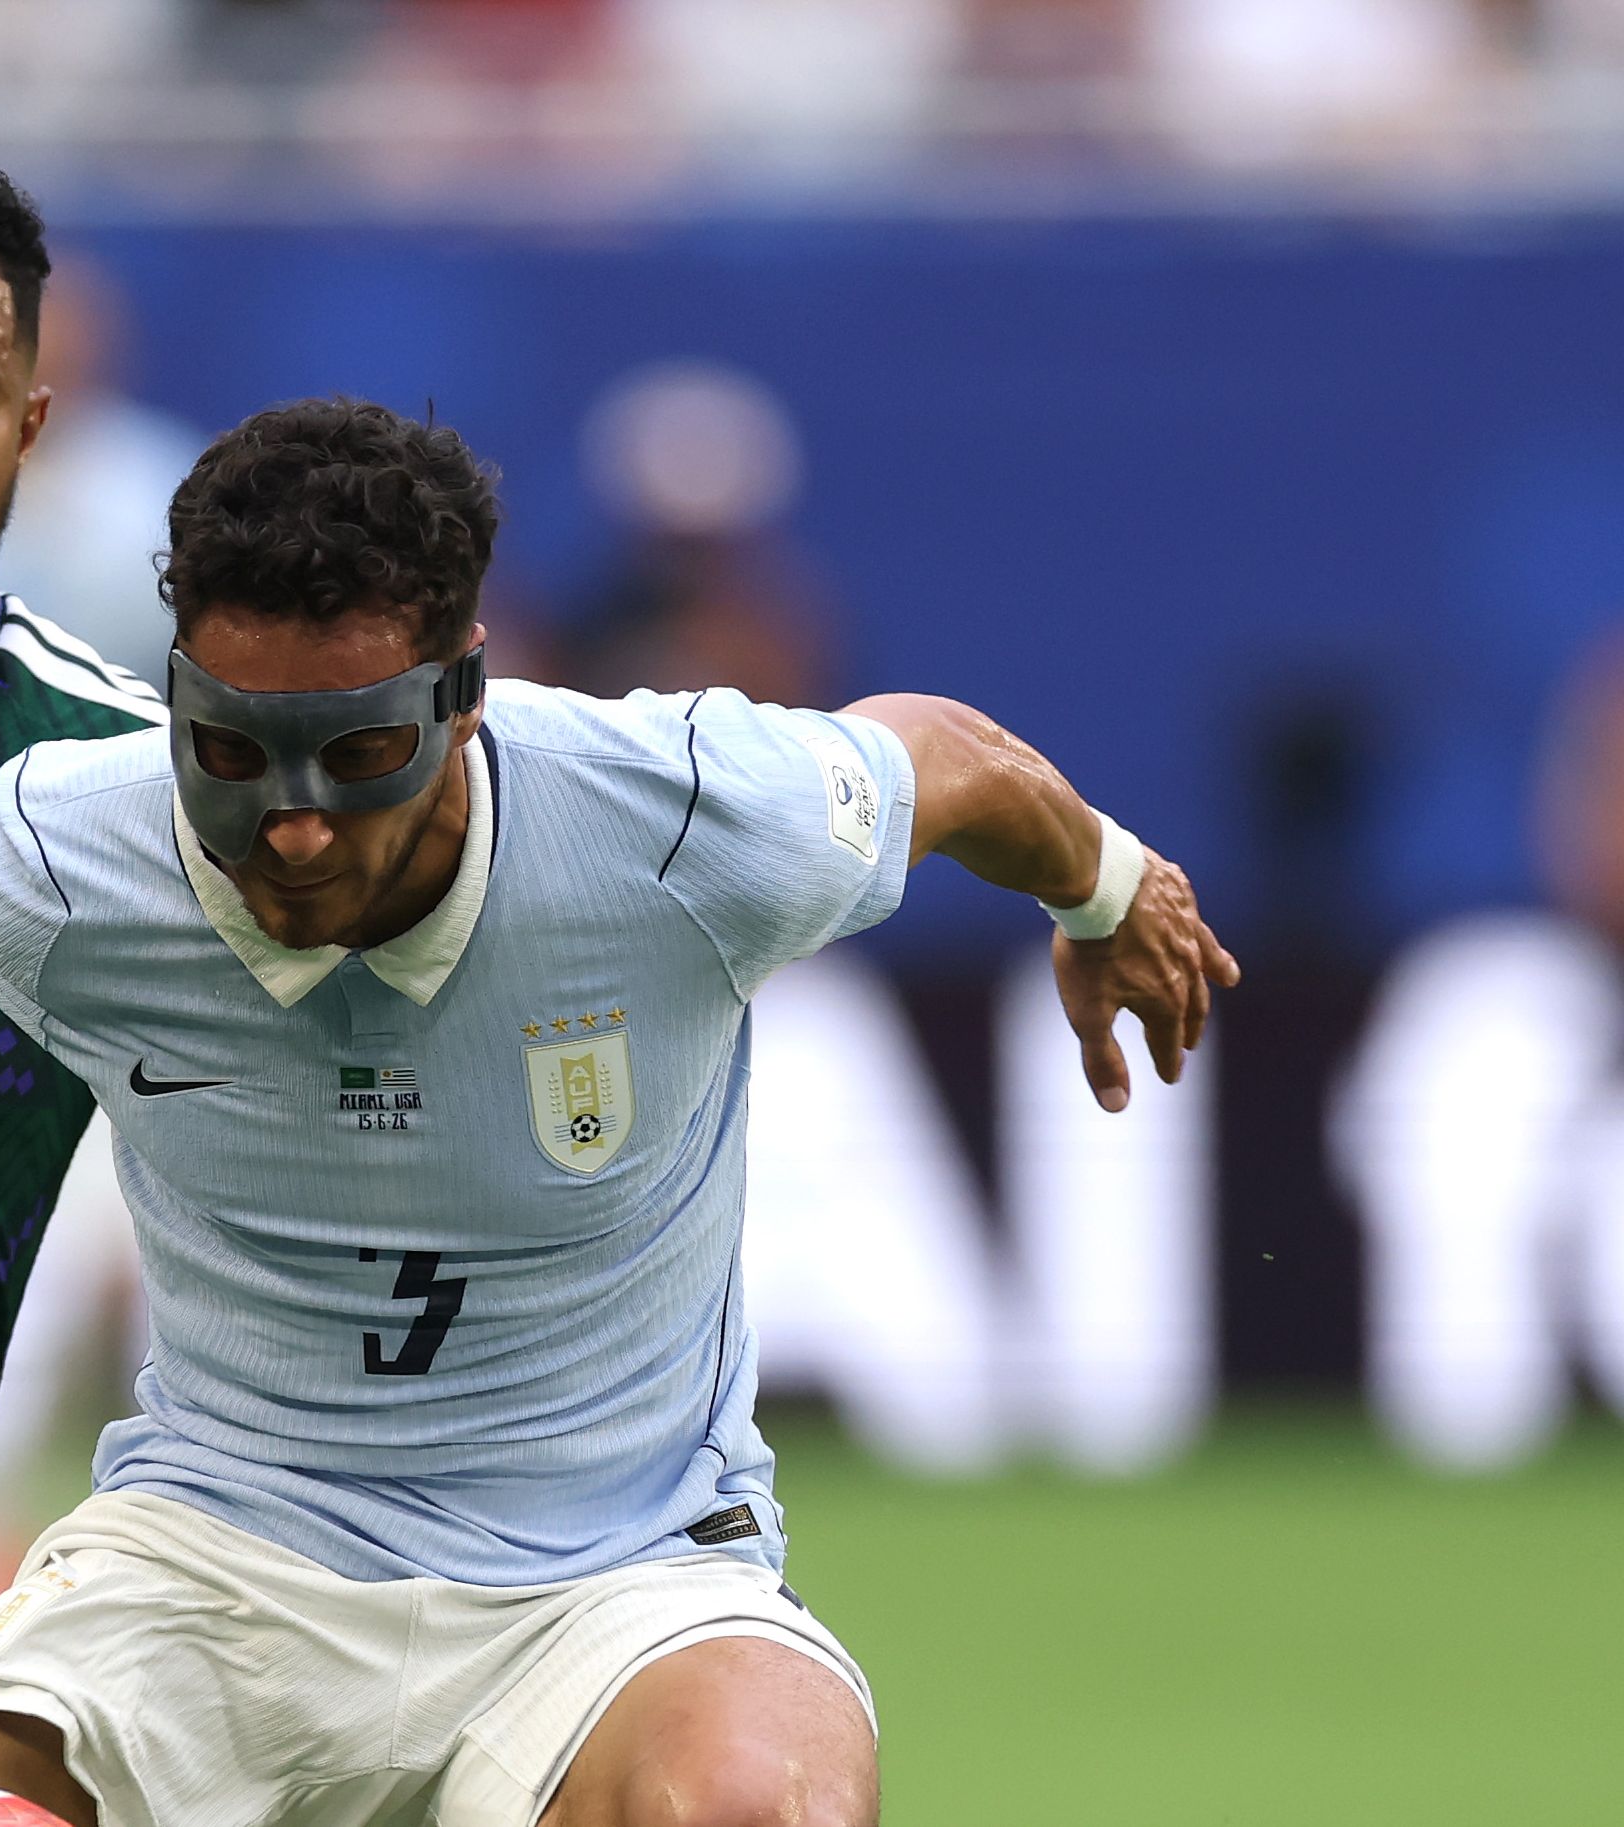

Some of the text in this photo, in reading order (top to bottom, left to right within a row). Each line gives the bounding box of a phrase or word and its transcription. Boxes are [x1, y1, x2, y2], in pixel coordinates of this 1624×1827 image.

[339, 1092, 423, 1111] MIAMI, USA
[568, 1065, 594, 1114] AUF
